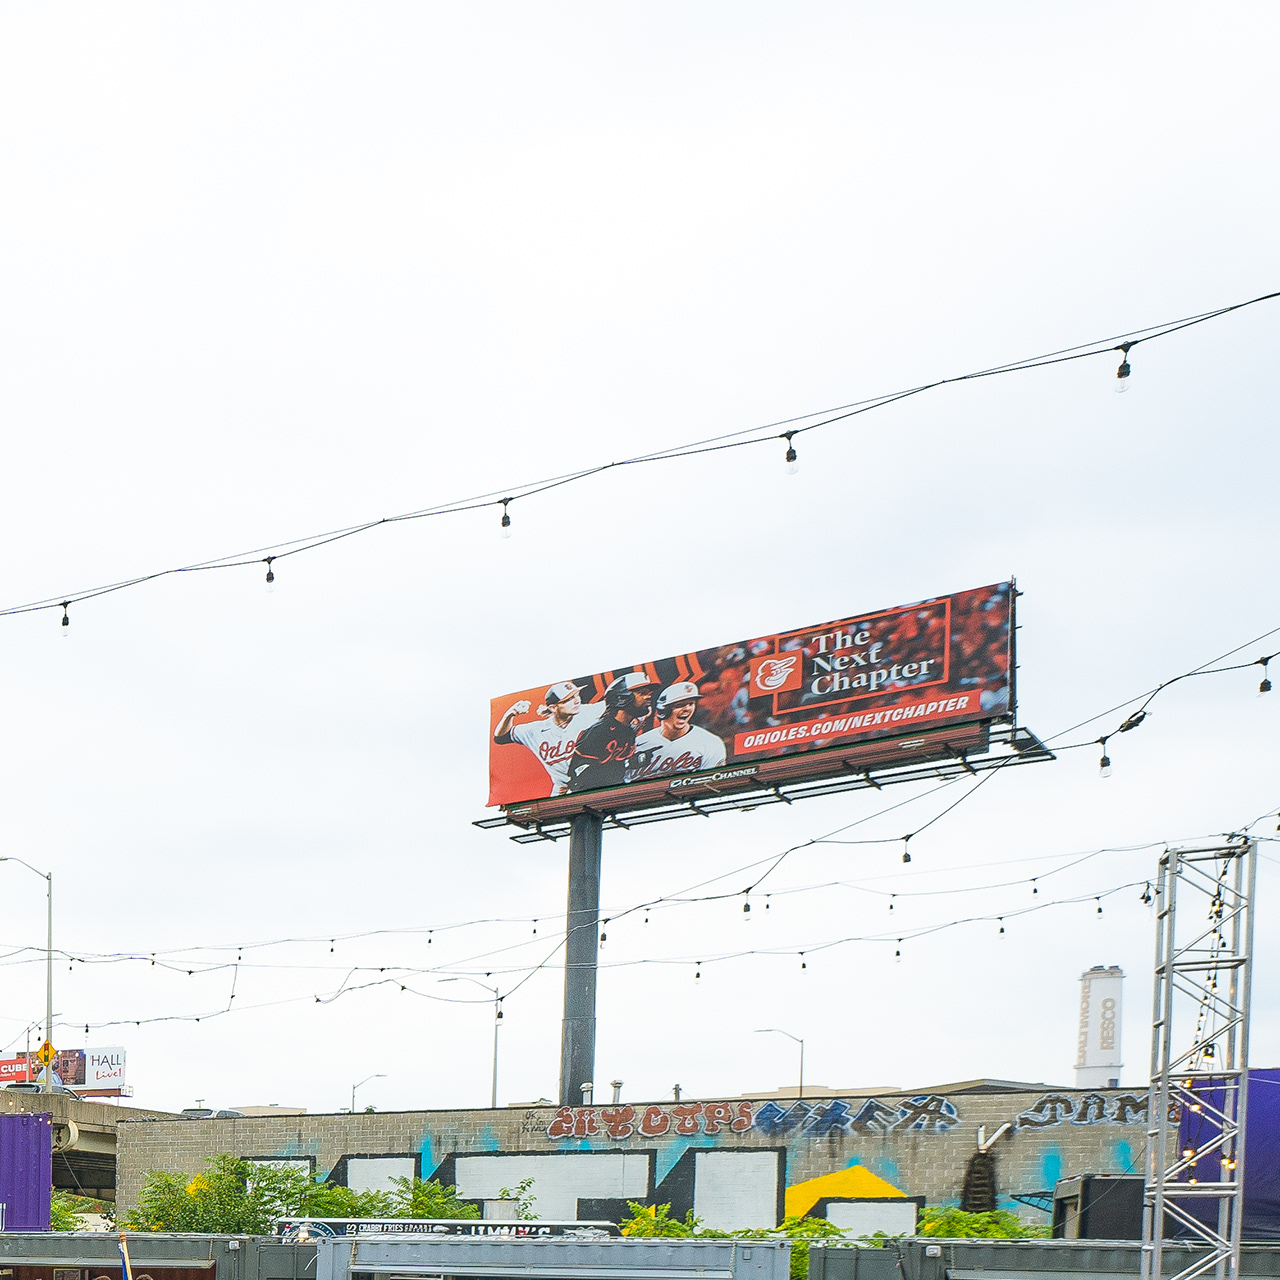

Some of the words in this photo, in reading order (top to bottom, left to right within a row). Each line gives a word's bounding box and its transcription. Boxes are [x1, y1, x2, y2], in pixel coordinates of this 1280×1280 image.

[813, 627, 871, 655] The
[812, 643, 882, 676] Next
[810, 655, 935, 698] Chapter
[743, 695, 969, 749] ORIOLES.COM/NEXTCHAPTER
[711, 766, 757, 782] CHANNEL
[1, 1063, 28, 1073] CUBE
[91, 1053, 122, 1071] HALL
[385, 1224, 404, 1233] FRIES
